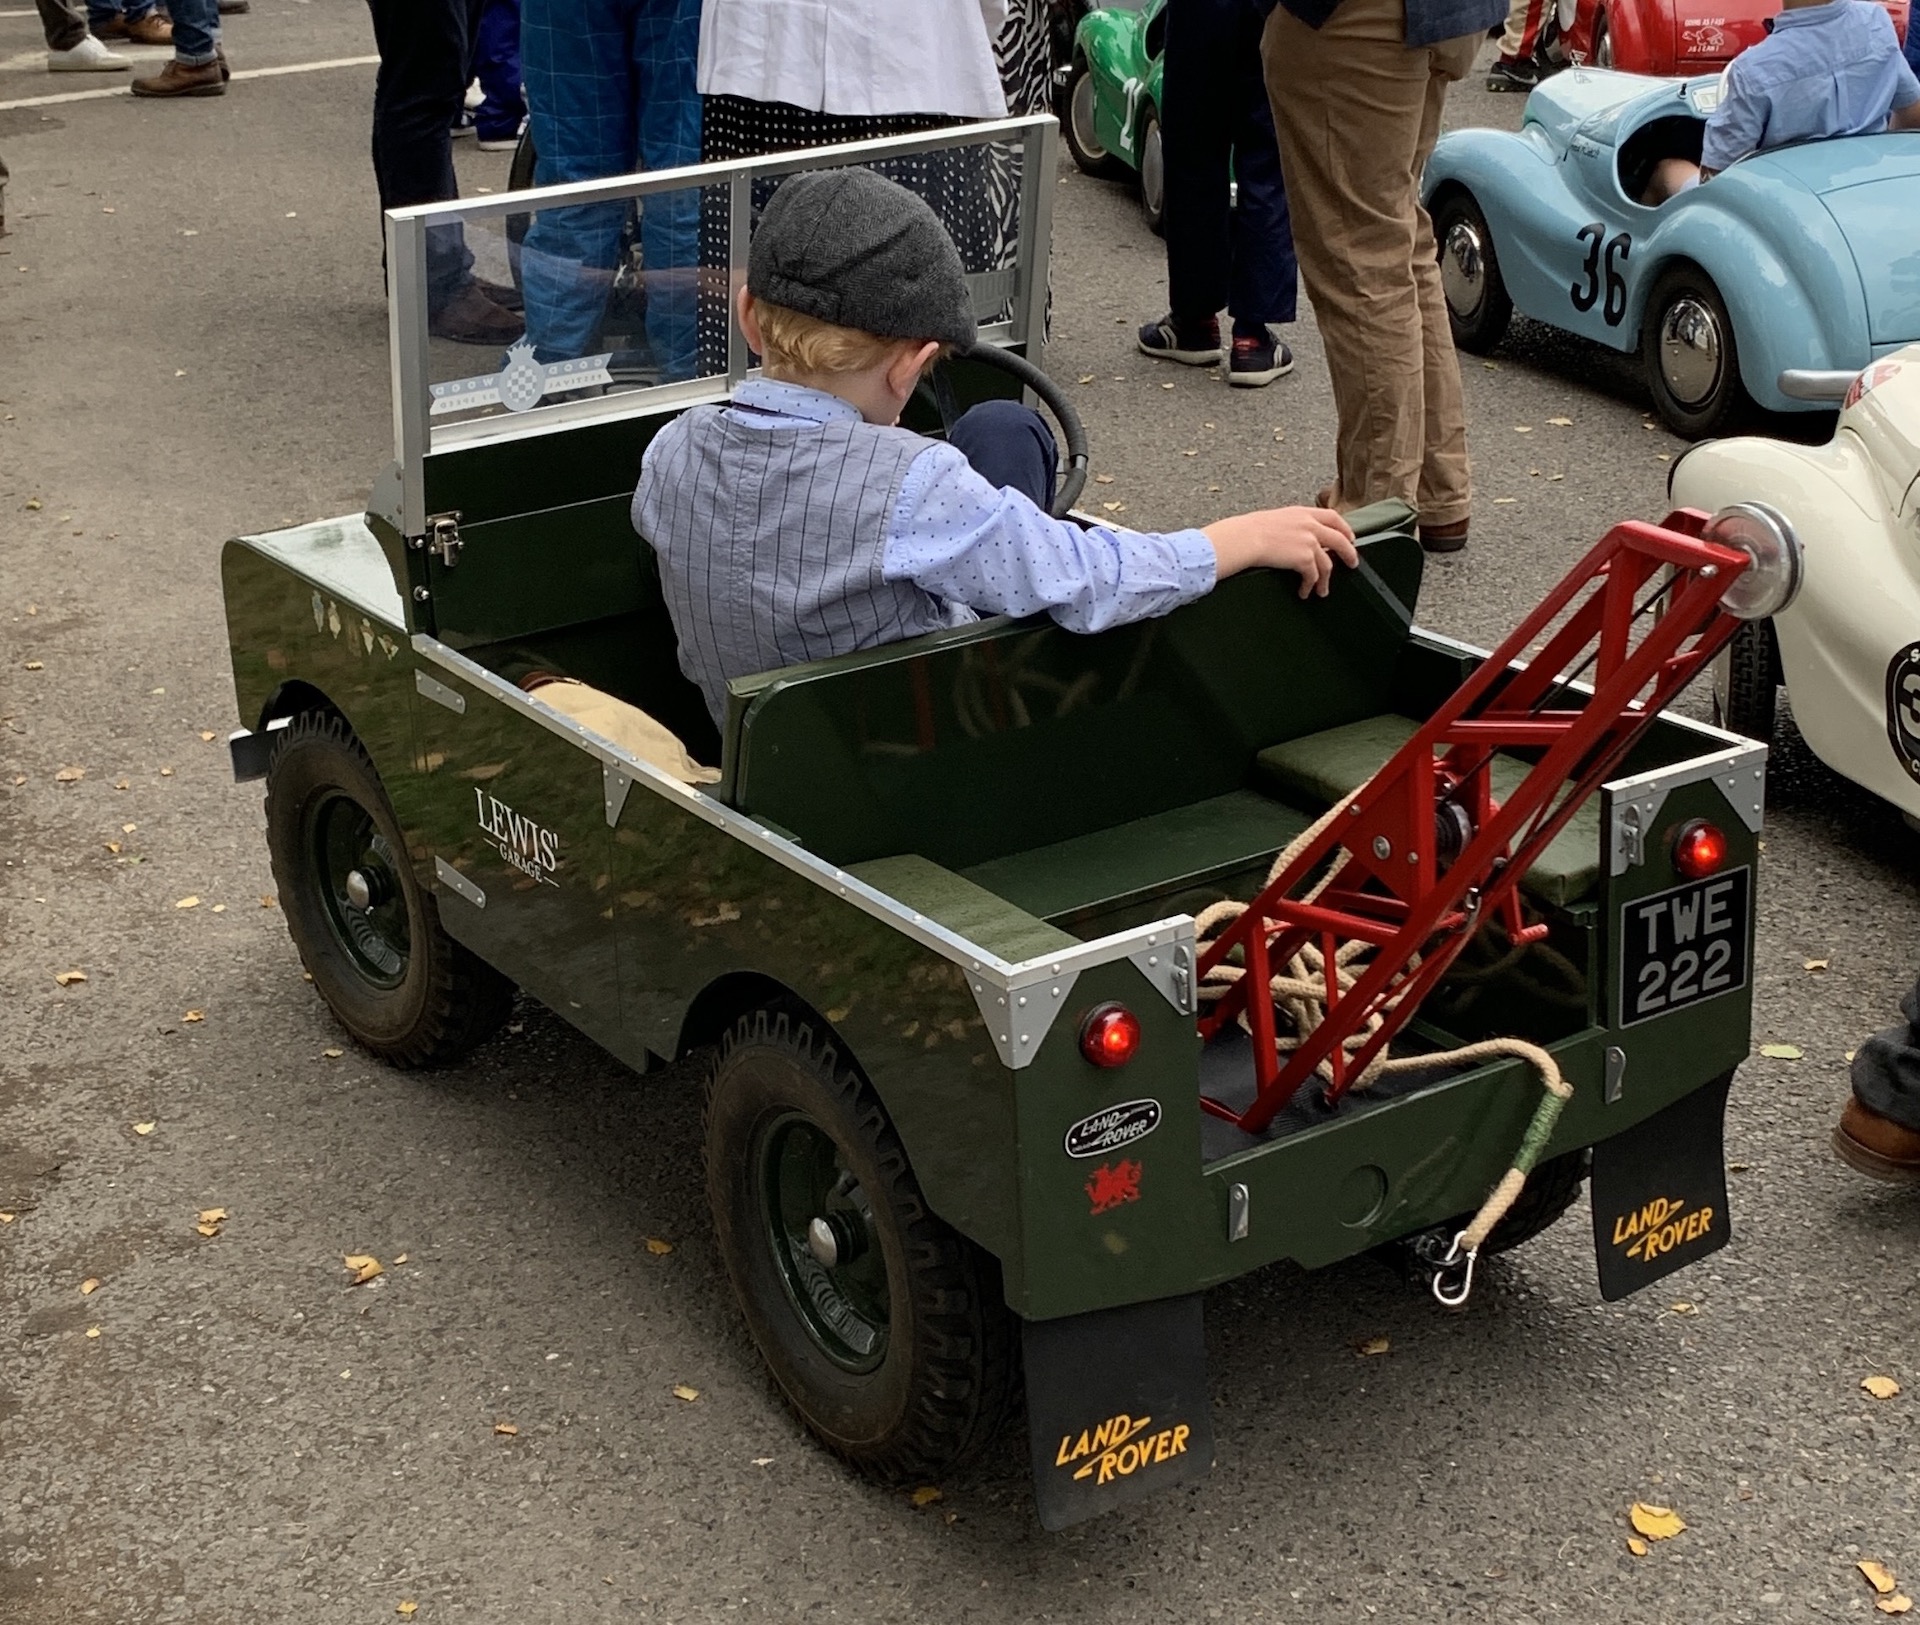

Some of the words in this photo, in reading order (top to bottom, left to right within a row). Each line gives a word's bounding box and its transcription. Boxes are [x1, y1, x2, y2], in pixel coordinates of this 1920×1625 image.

[1570, 222, 1632, 328] 36
[499, 843, 542, 883] GARAGE
[1639, 880, 1733, 954] TWE
[1637, 939, 1732, 1014] 222
[1080, 1111, 1121, 1137] LAND
[1101, 1119, 1148, 1147] ROVER
[1612, 1197, 1669, 1246] LAND
[1644, 1206, 1713, 1263] ROVER
[1055, 1414, 1132, 1467] LAND
[1097, 1423, 1191, 1486] ROVER
